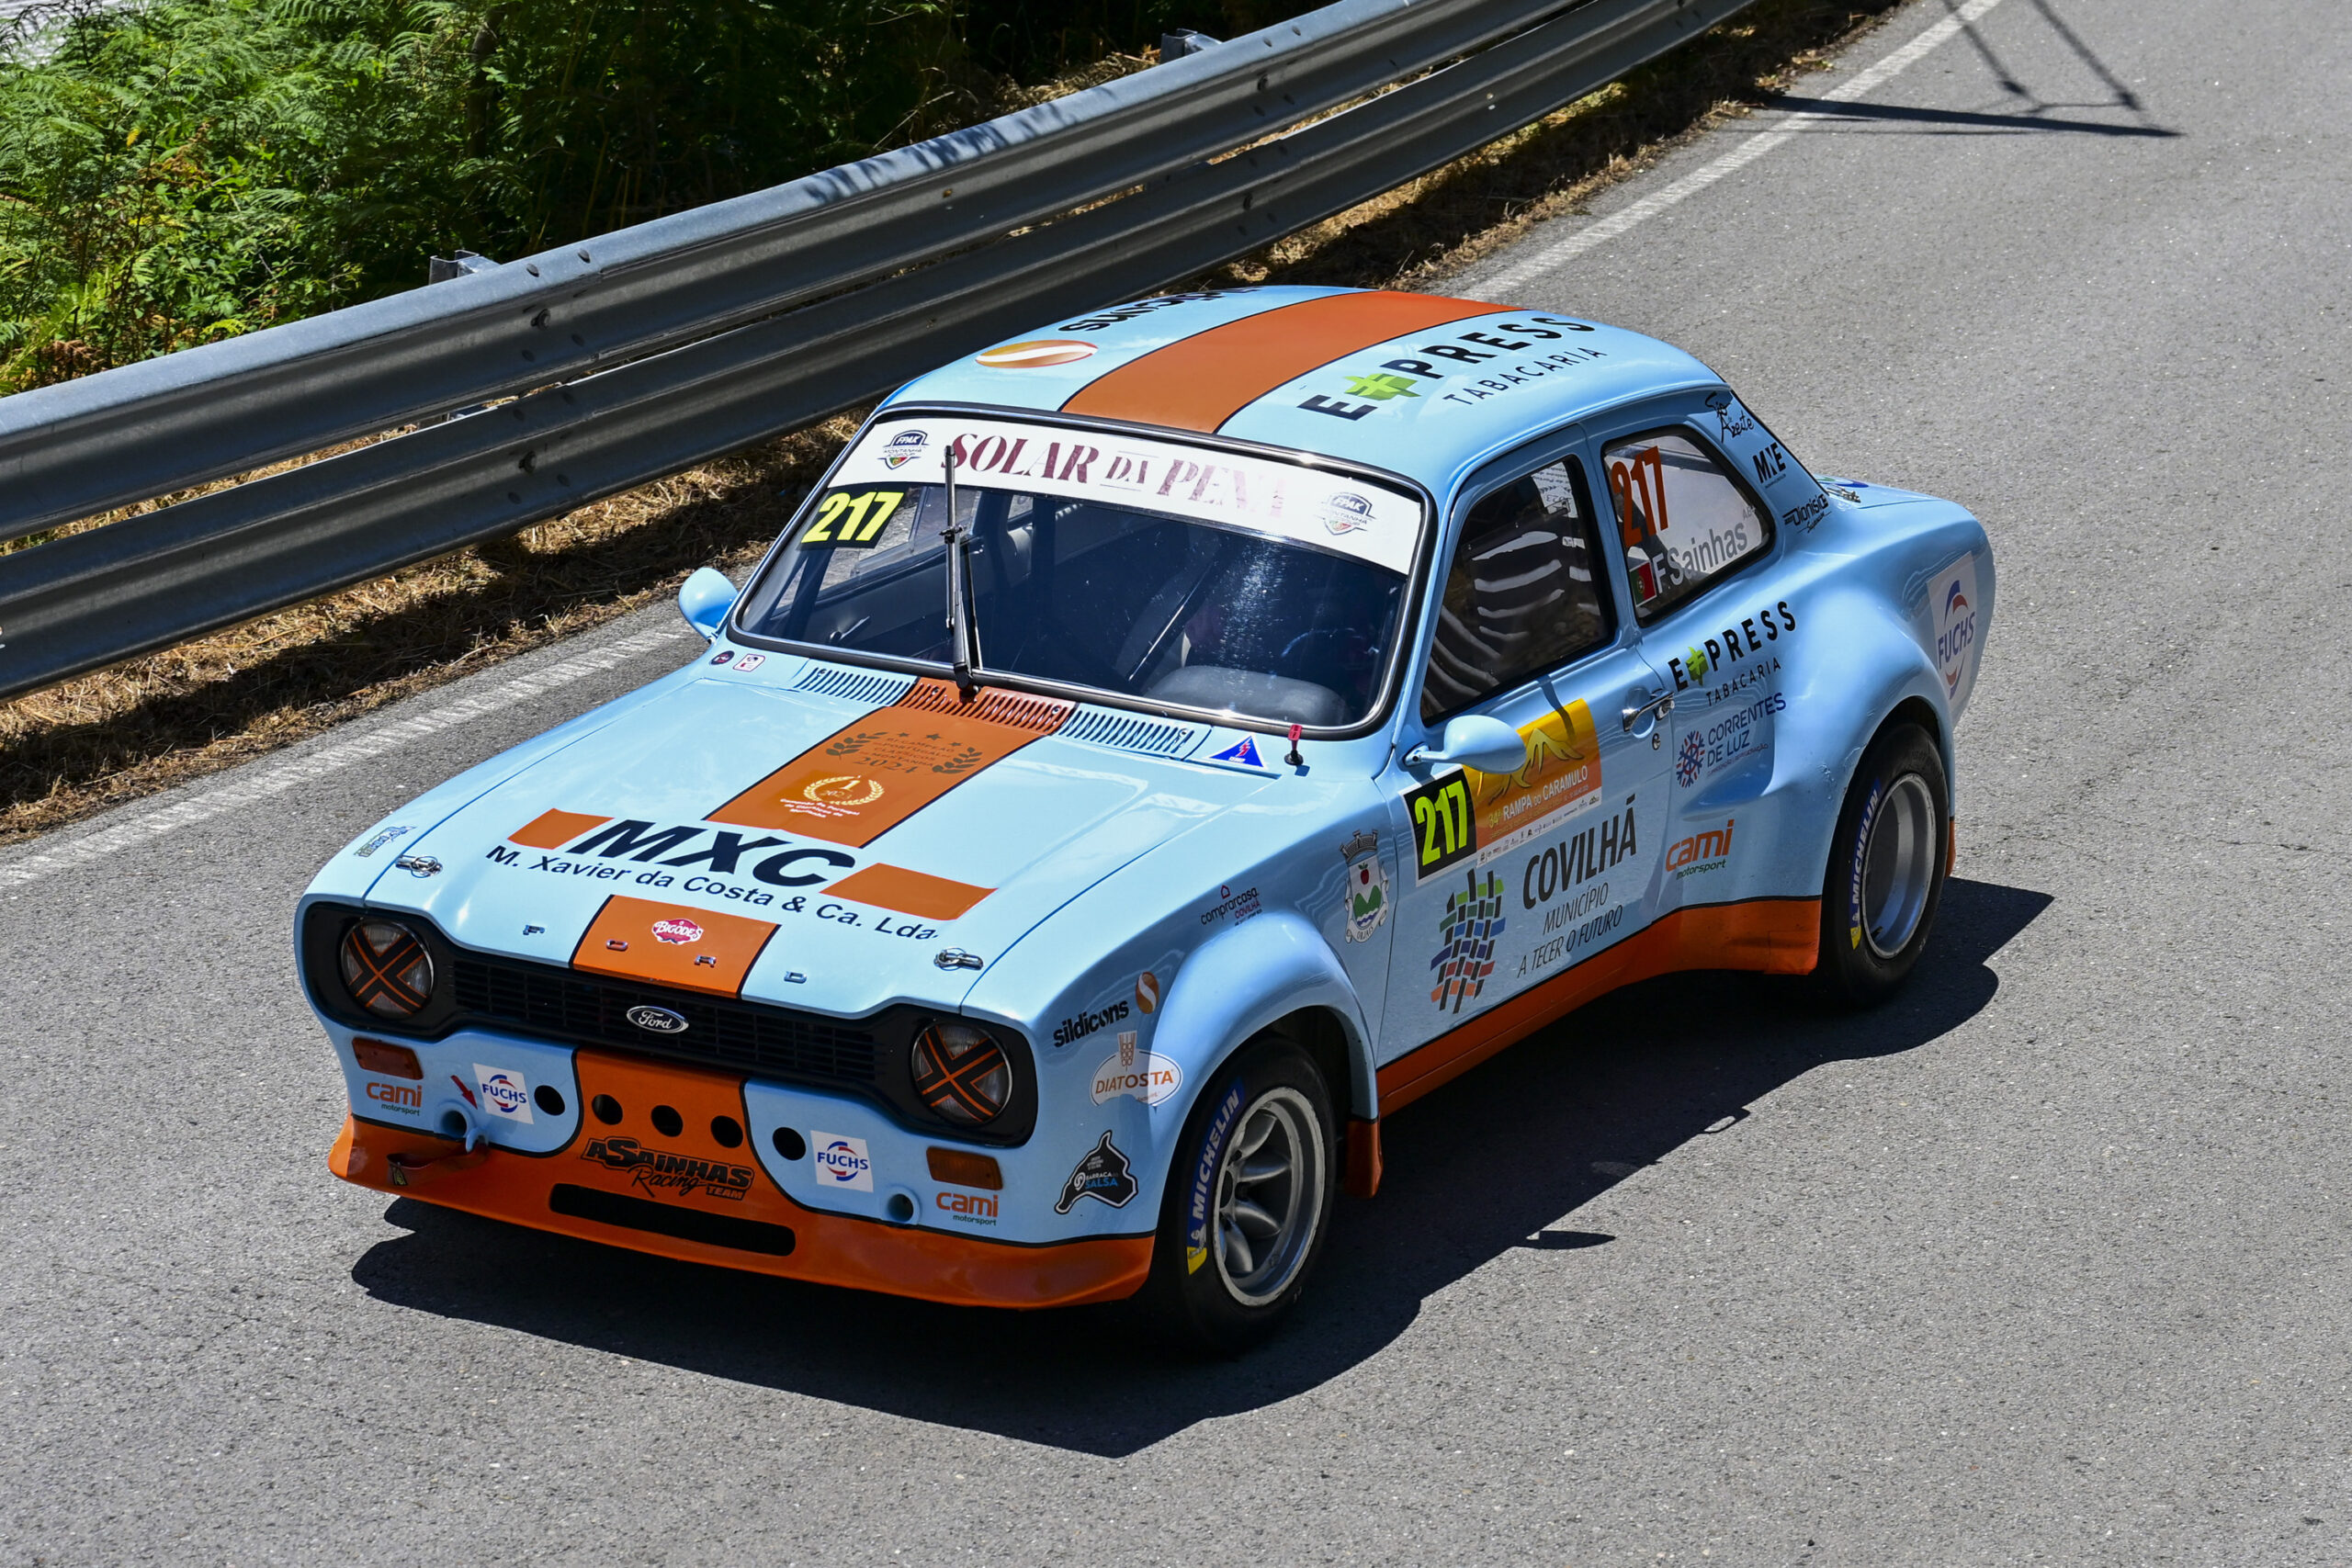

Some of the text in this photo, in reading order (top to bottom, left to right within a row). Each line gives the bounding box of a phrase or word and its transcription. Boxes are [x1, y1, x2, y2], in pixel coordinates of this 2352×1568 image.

[1442, 346, 1608, 405] TABACARIA
[941, 434, 1100, 483] SOLAR
[1105, 457, 1148, 483] DA
[801, 491, 905, 544] 217
[1611, 446, 1668, 548] 217
[1937, 611, 1975, 670] FUCHS
[1706, 657, 1781, 706] TABACARIA
[1708, 692, 1787, 746] CORRENTES
[853, 757, 918, 773] 2024
[1707, 744, 1724, 767] DE
[1726, 729, 1750, 757] LUZ
[1503, 794, 1533, 821] RAMPA
[1543, 765, 1589, 801] CARAMULO
[1415, 780, 1468, 866] 217
[1665, 818, 1735, 873] cami
[1852, 789, 1879, 906] MICHELIN
[565, 818, 855, 887] MXC
[1676, 859, 1727, 880] motorsport
[486, 845, 519, 868] M.
[528, 854, 632, 883] Xavier
[636, 870, 675, 887] da
[684, 875, 771, 908] Costa
[781, 896, 808, 914] &
[817, 903, 864, 929] Ca.
[1543, 882, 1609, 936] MUNICÍPIO
[1518, 904, 1623, 978] A TECER O FUTURO
[638, 1011, 674, 1031] Ford
[1053, 1000, 1130, 1048] sildicons
[367, 1081, 423, 1108] cami
[482, 1084, 527, 1105] FUCHS
[1095, 1070, 1174, 1095] DIATOSTA
[381, 1104, 421, 1117] motorsport
[818, 1152, 869, 1170] FUCHS
[1193, 1089, 1240, 1221] MICHELIN
[627, 1163, 707, 1198] Racing
[707, 1185, 743, 1201] TEAM
[935, 1192, 999, 1218] cami
[1085, 1177, 1118, 1190] SALSA
[953, 1214, 998, 1226] motorsport
